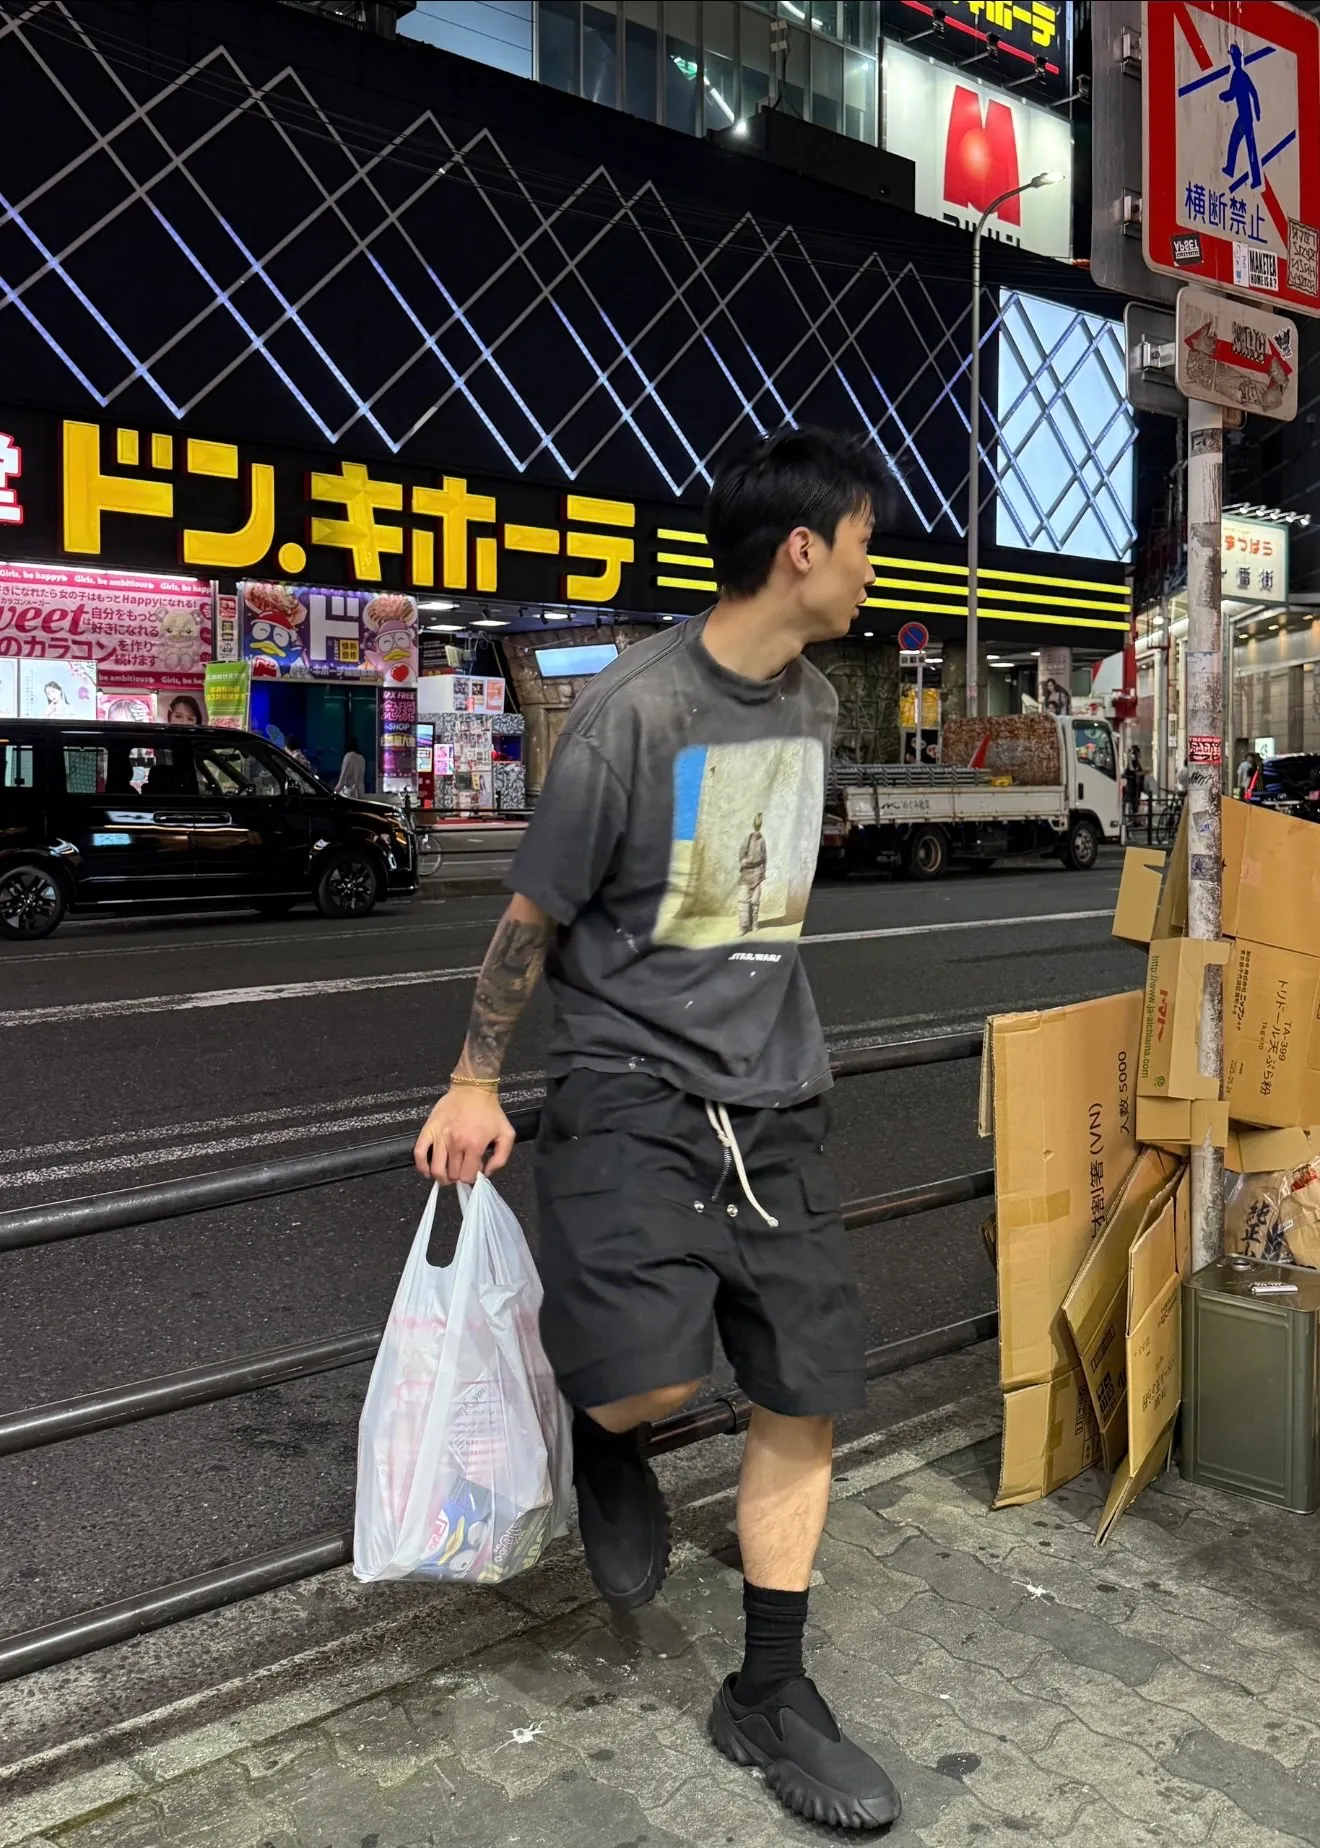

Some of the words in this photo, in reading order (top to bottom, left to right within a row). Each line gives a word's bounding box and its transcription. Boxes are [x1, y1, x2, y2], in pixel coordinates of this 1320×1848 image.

[1185, 180, 1268, 244] 横断禁止
[1225, 535, 1273, 556] まつばら
[74, 575, 96, 586] Girls,
[97, 577, 108, 586] be
[109, 578, 149, 589] ambitious
[160, 582, 181, 593] Girls,
[0, 585, 197, 609] きになれたら女の子はもっとHappyになれる!
[91, 607, 157, 623] 自分をもっと
[91, 622, 159, 638] 好きになれる
[309, 594, 360, 661] ド
[118, 639, 153, 652] を作り
[114, 653, 159, 667] 続けます
[396, 691, 415, 700] FREE
[388, 722, 410, 731] SHOP
[1260, 979, 1289, 1096] トリドール天ぷら粉
[1278, 1021, 1292, 1062] TA-399
[1117, 1051, 1127, 1093] 5000
